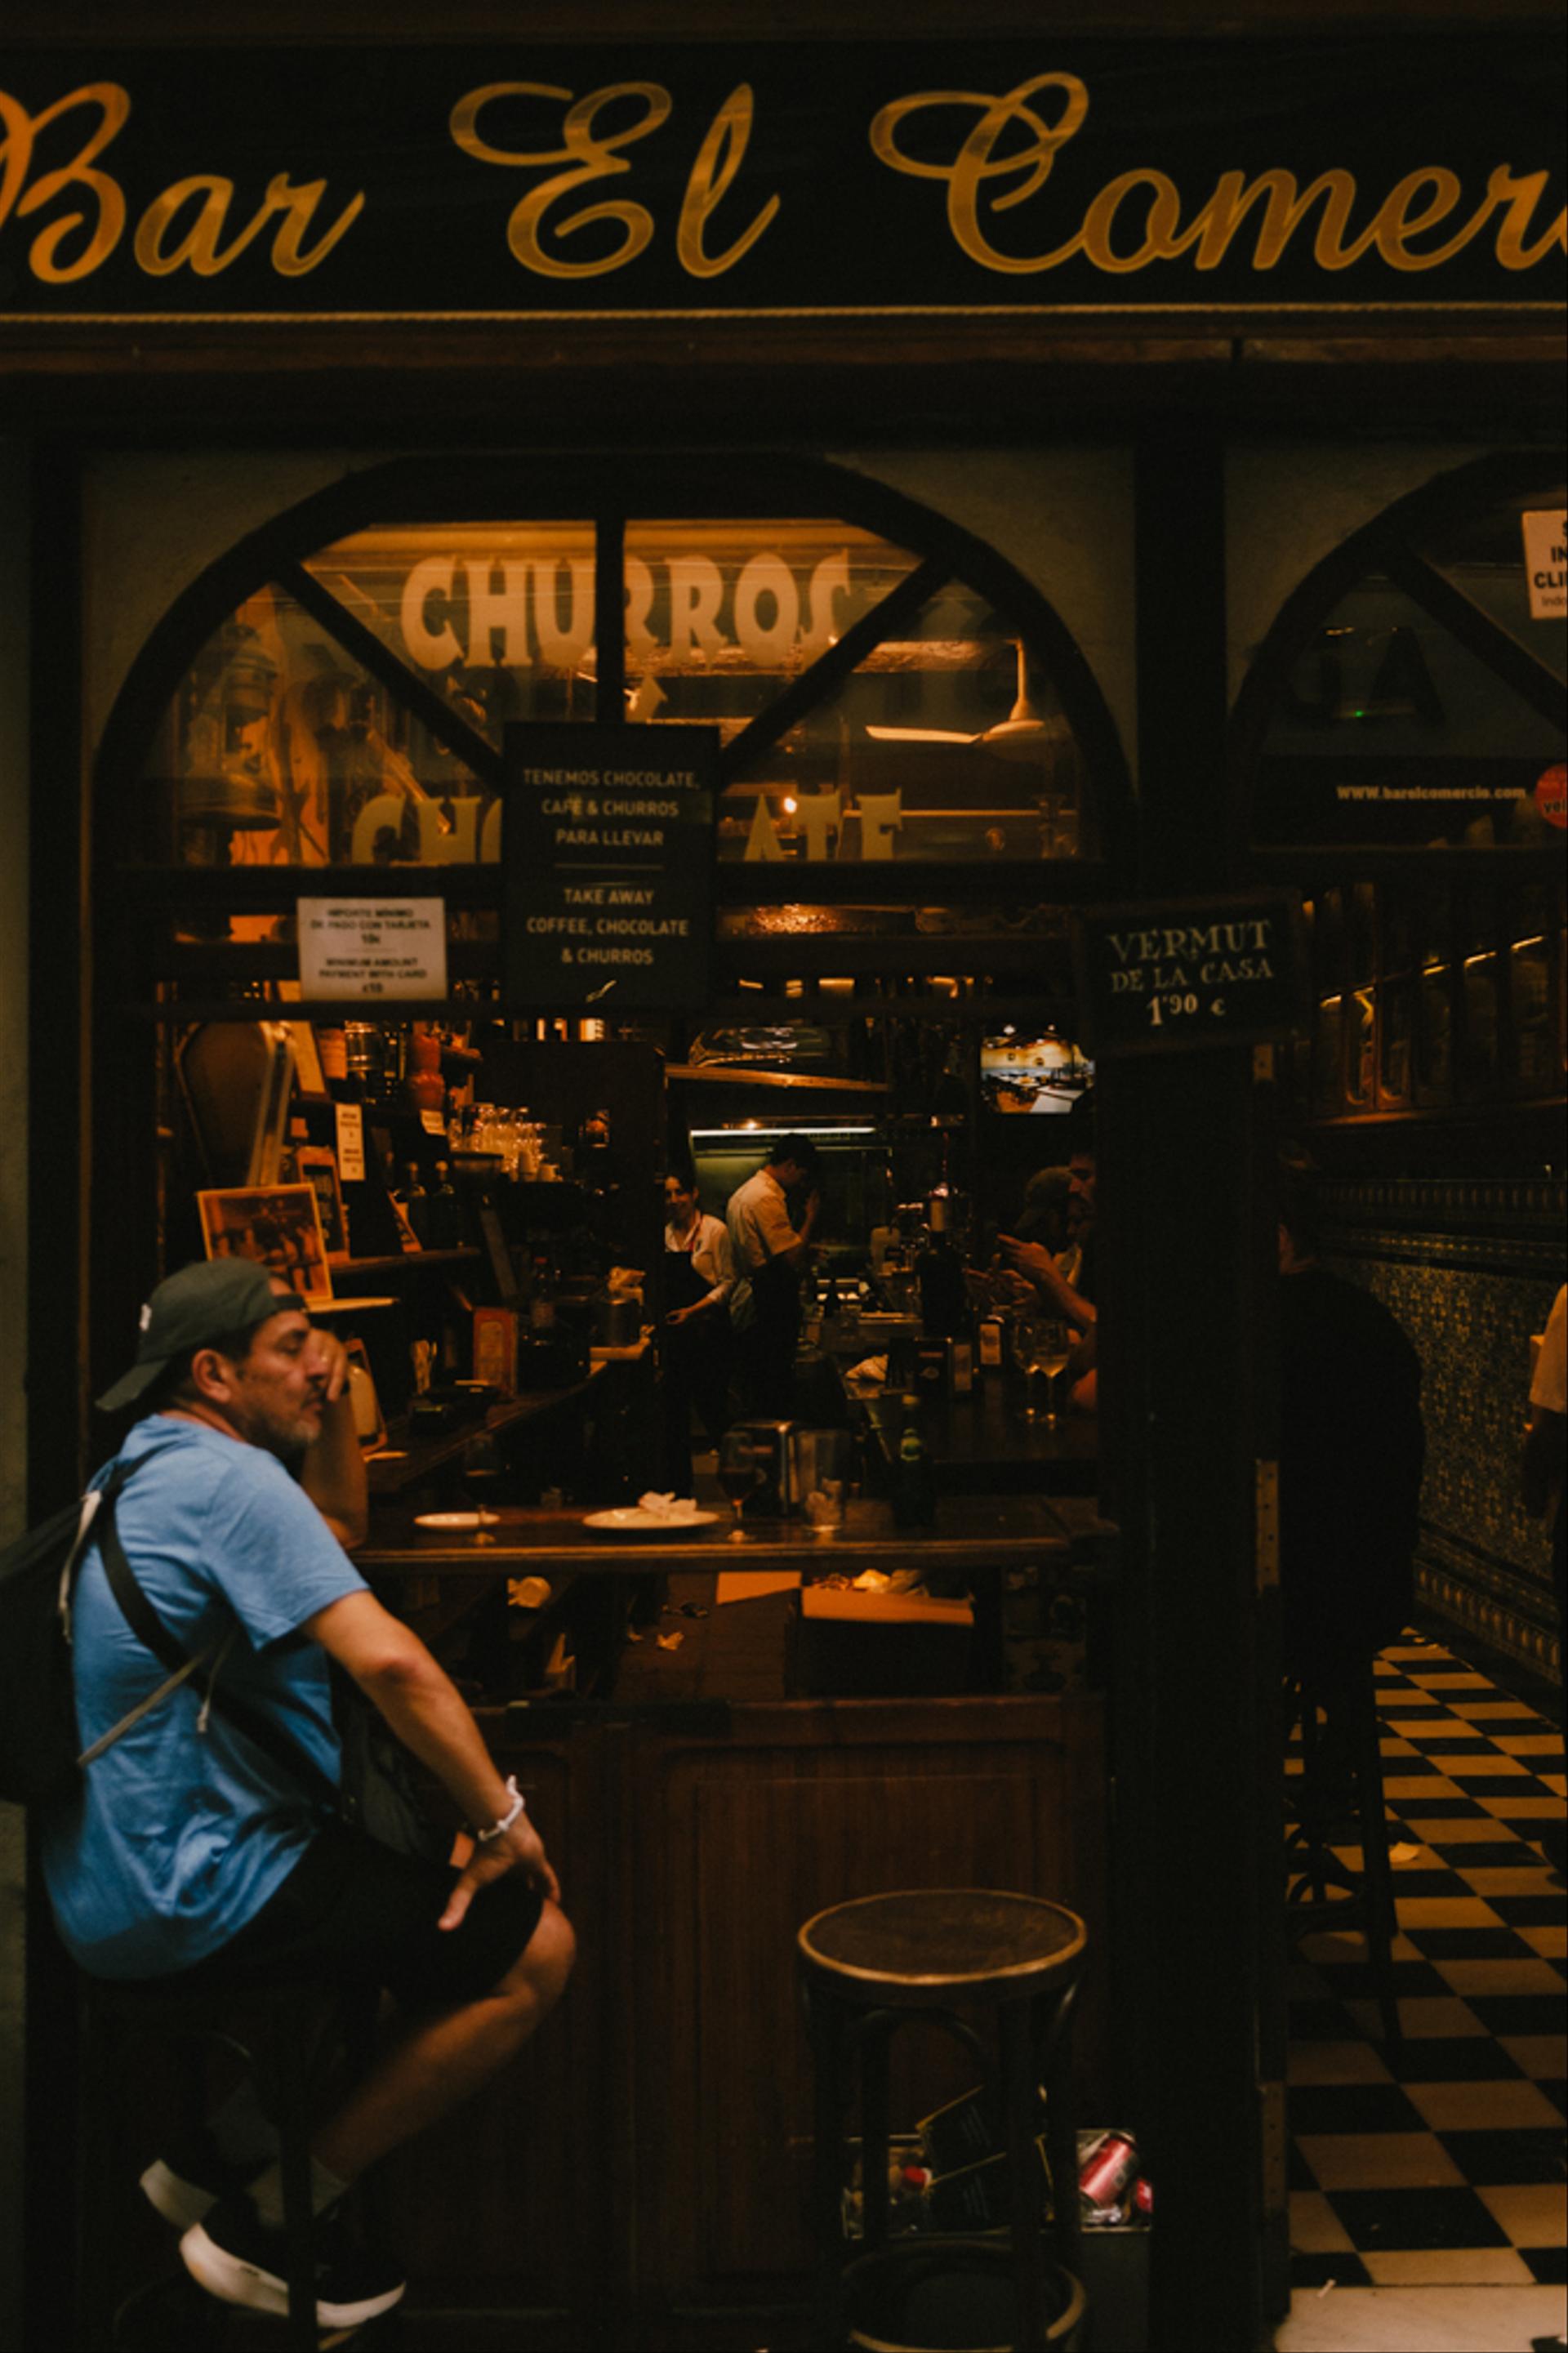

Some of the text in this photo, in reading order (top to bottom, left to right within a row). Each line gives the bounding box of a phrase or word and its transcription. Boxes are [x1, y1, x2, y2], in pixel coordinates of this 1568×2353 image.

[0, 70, 1567, 284] Bar El Comer
[523, 769, 701, 790] TENEMOS CHOCOLATE,
[587, 800, 598, 815] &
[603, 800, 679, 816] CHURROS
[555, 828, 664, 846] PARA LLEVAR
[564, 889, 654, 906] TAKE AWAY
[526, 917, 689, 936] COFFEE, CHOCOLATE
[1108, 918, 1271, 964] VERMUT
[561, 948, 653, 965] & CHURROS
[1109, 956, 1275, 994] DE LA CASA
